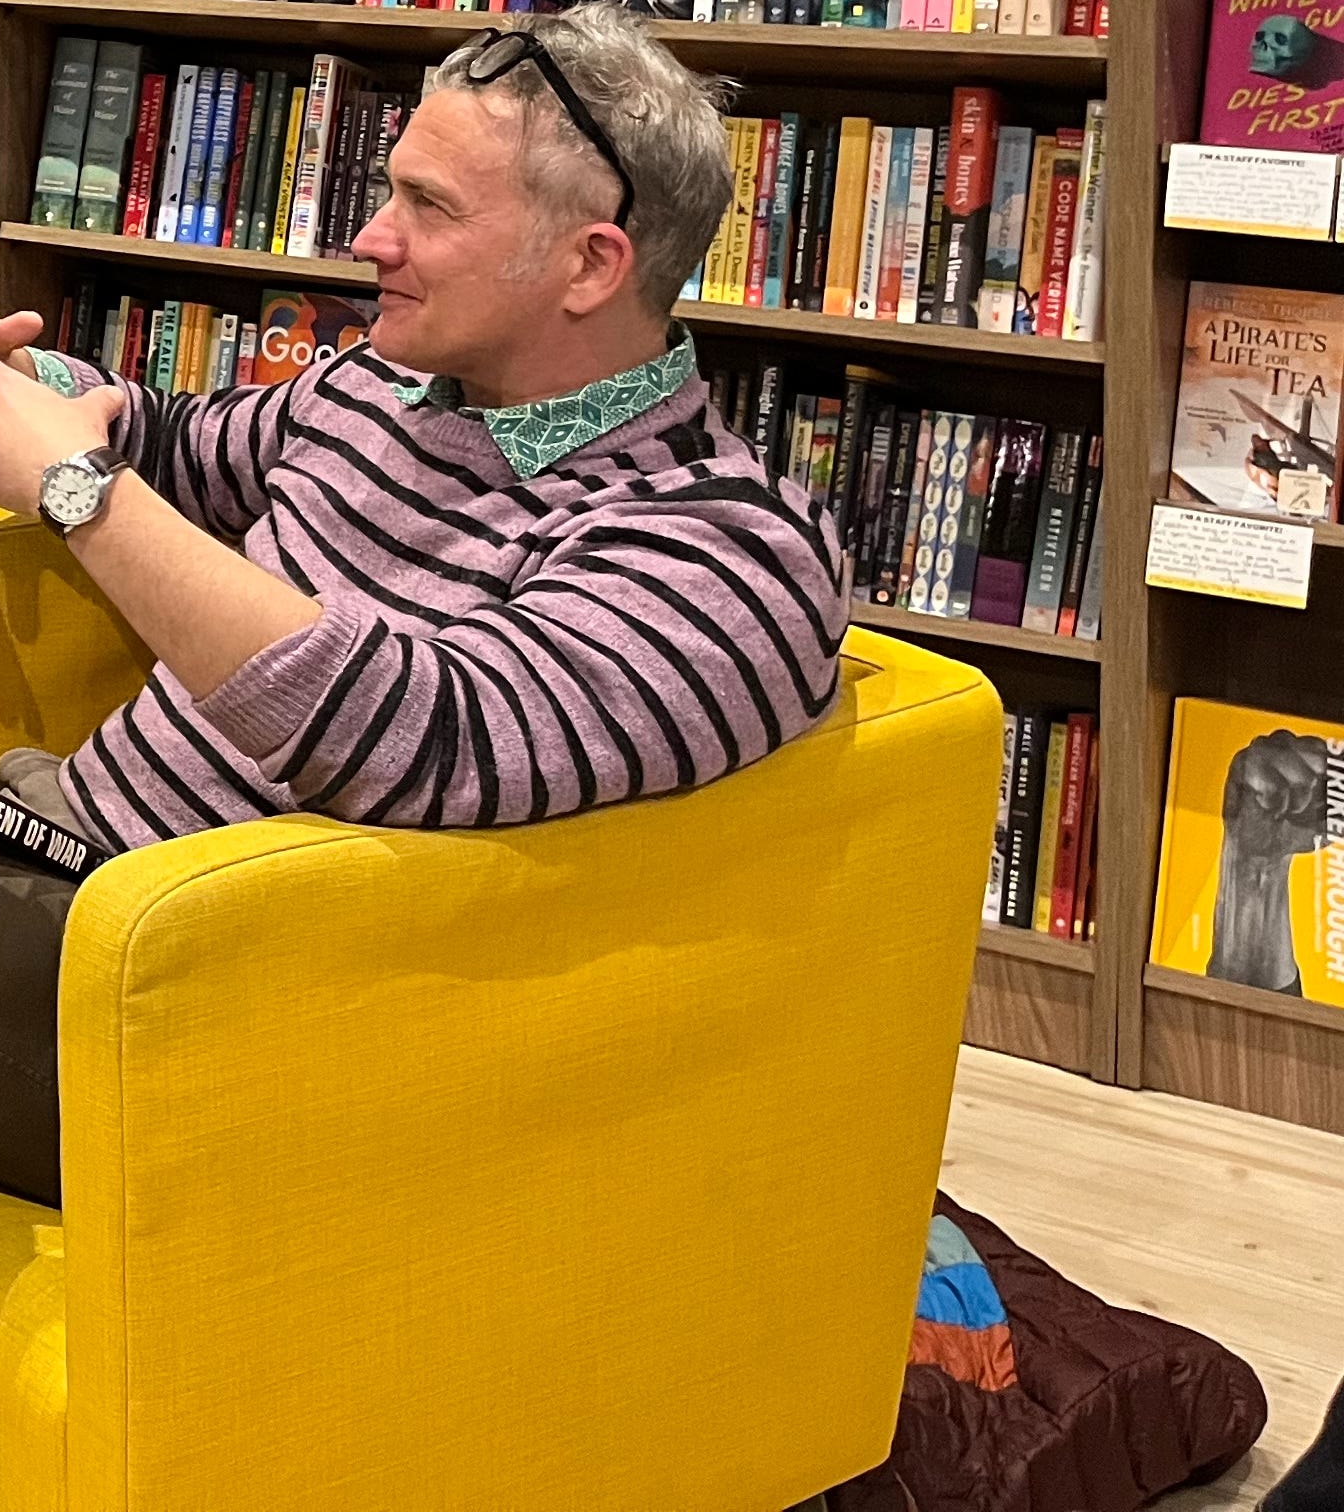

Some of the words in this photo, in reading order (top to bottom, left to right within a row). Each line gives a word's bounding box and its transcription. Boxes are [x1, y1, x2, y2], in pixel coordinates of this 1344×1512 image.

[964, 95, 977, 134] skin
[1227, 82, 1306, 111] DIES
[1247, 97, 1344, 136] FIRST
[955, 156, 976, 206] bones
[1057, 181, 1071, 216] CODE
[1084, 175, 1102, 224] Weiner
[1053, 219, 1068, 257] NAME
[1042, 260, 1063, 320] VERITY
[166, 305, 176, 332] THE
[1204, 320, 1217, 334] A
[1221, 320, 1328, 354] PIRATE'S
[160, 338, 173, 375] FAKE
[261, 326, 365, 364] Goo
[1209, 342, 1261, 367] LIFE
[1264, 352, 1290, 366] FOR
[1265, 367, 1328, 397] TEA
[23, 819, 47, 850] OF
[46, 830, 87, 872] WAR
